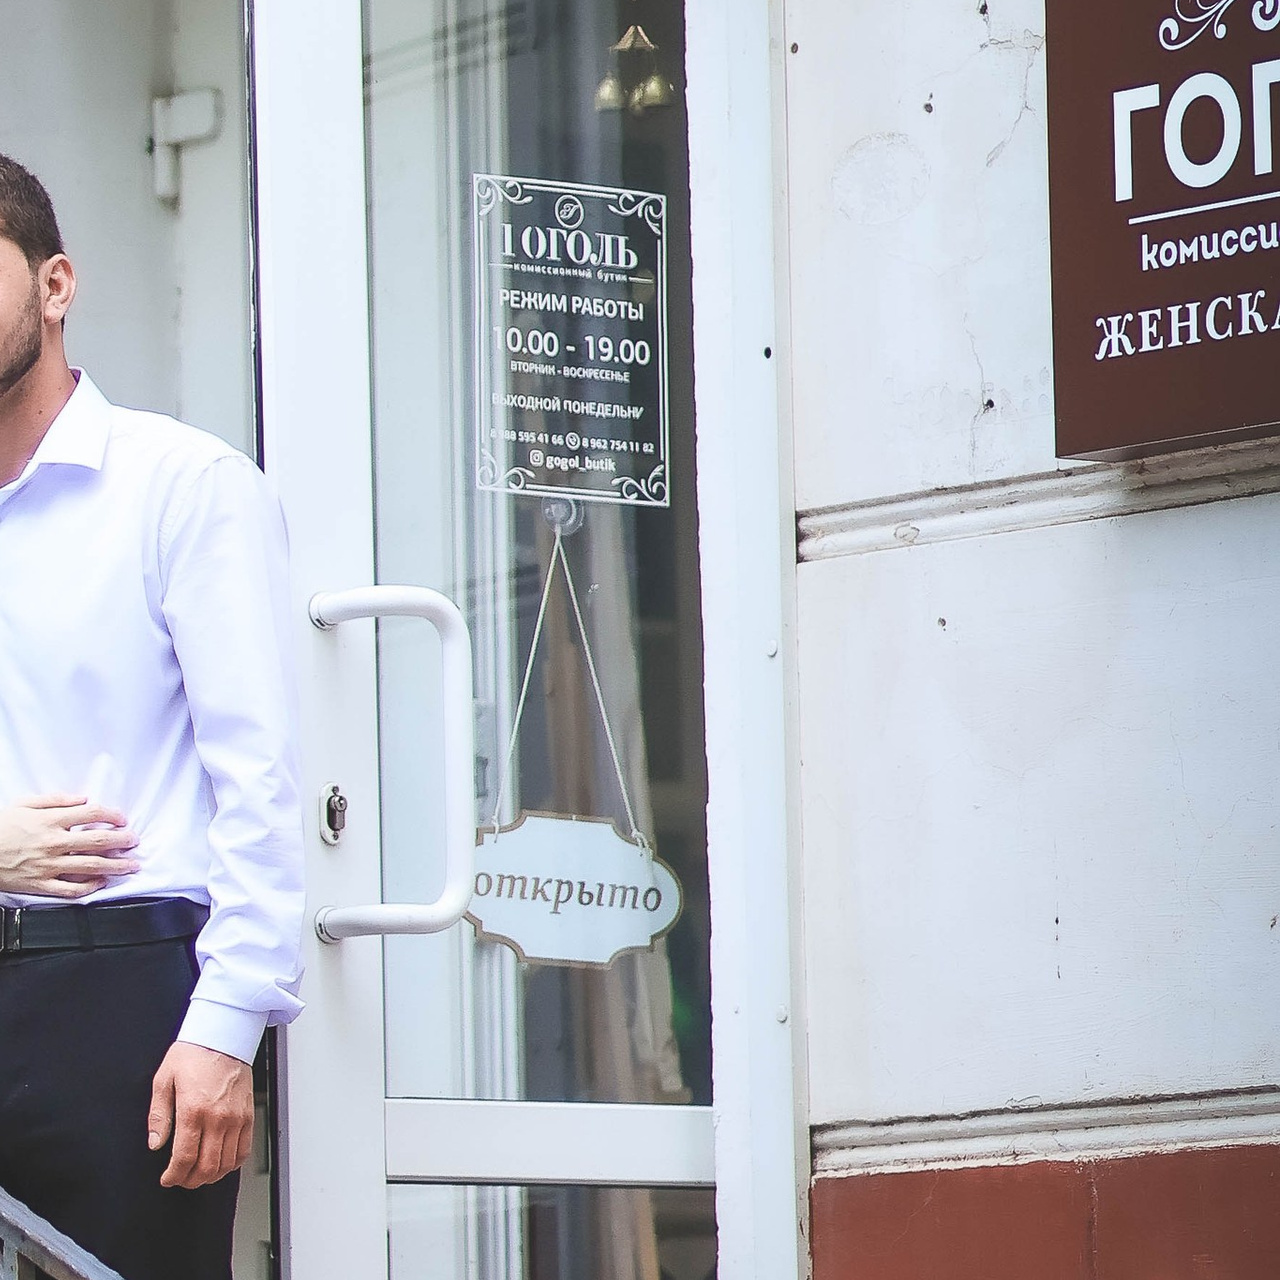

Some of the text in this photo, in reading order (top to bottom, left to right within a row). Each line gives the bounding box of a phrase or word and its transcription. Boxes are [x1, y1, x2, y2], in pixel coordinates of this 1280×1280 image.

[499, 289, 644, 321] РЕЖИМ РАБОТЫ
[493, 326, 560, 358] 10.00
[584, 335, 651, 366] 19.00
[510, 361, 556, 376] ВТОРНИК
[563, 366, 630, 383] ВОСКРЕСЕНЬЕ
[492, 393, 561, 413] ВЫХОДНОЙ
[537, 432, 549, 445] 41
[551, 434, 564, 446] 66
[546, 454, 616, 471] gogol_butik
[474, 872, 662, 914] открыто
